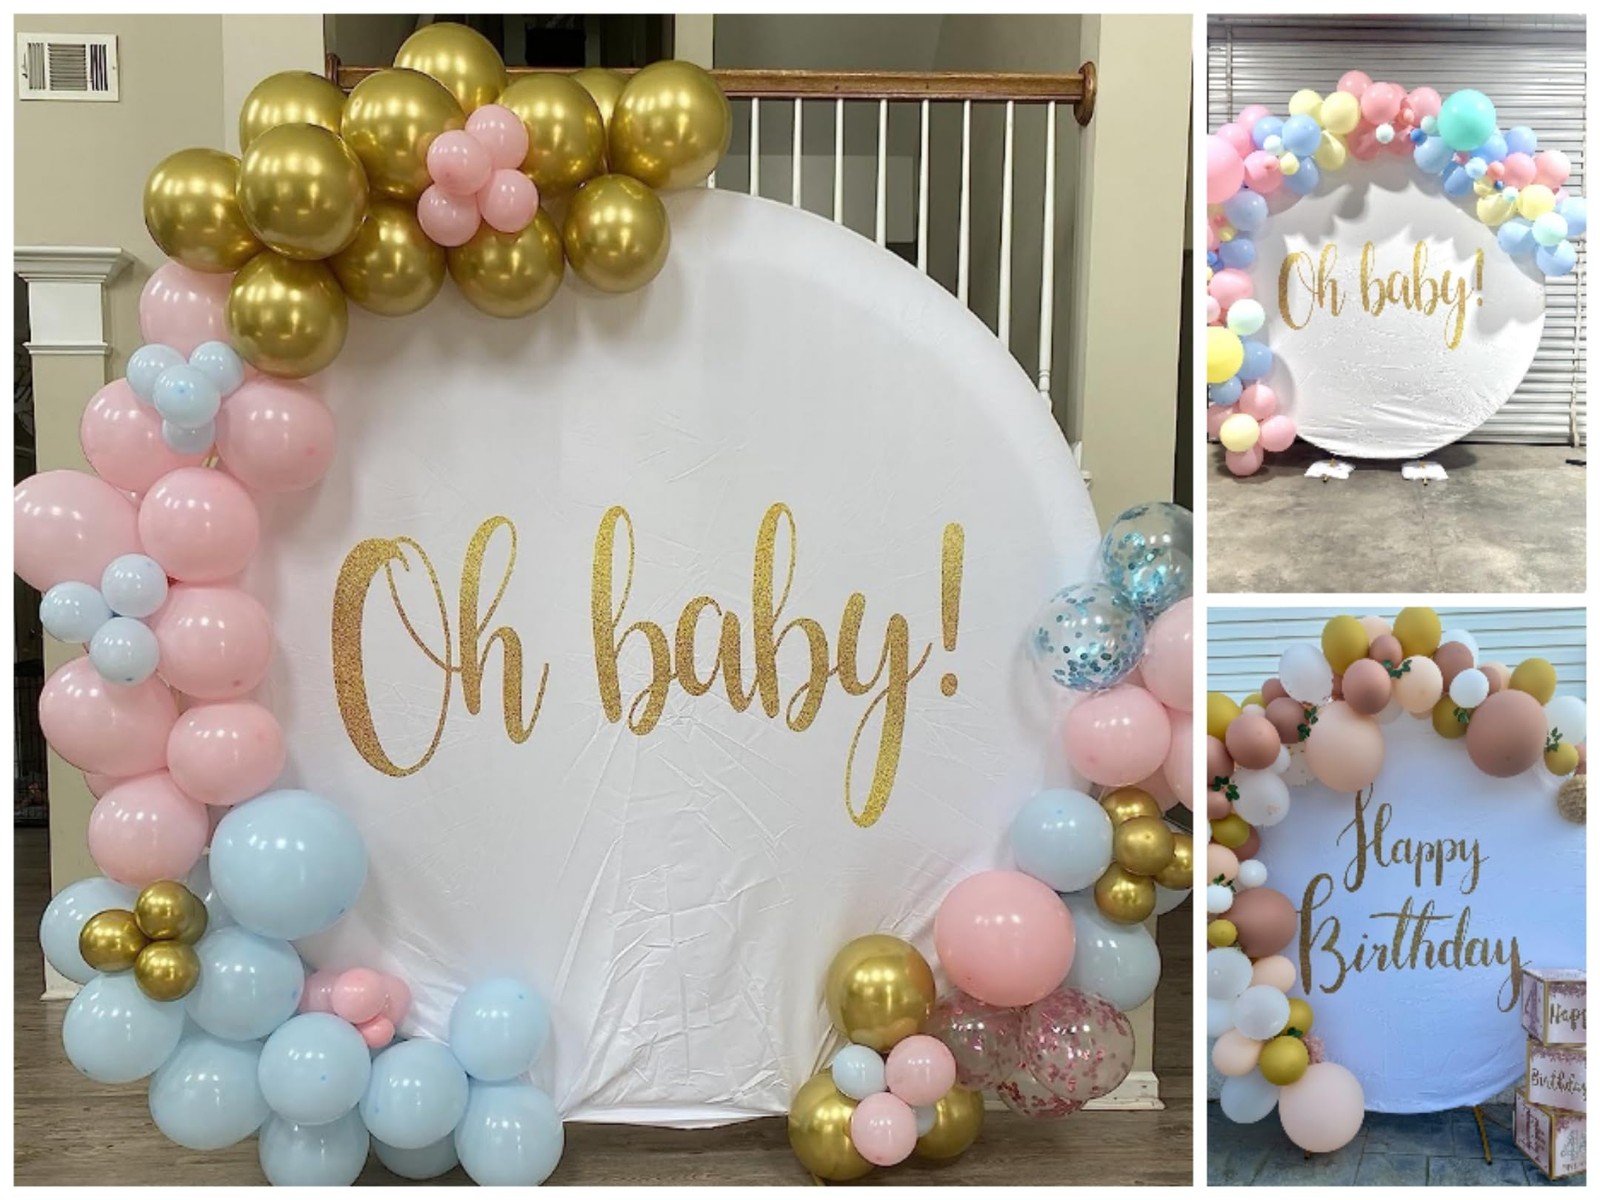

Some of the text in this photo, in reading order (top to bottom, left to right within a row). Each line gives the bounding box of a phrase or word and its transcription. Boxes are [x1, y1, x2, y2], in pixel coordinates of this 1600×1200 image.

[1278, 240, 1485, 351] Oh baby!
[331, 501, 965, 828] Oh baby!
[1336, 782, 1490, 895] Happy
[1296, 873, 1532, 1013] Birthday
